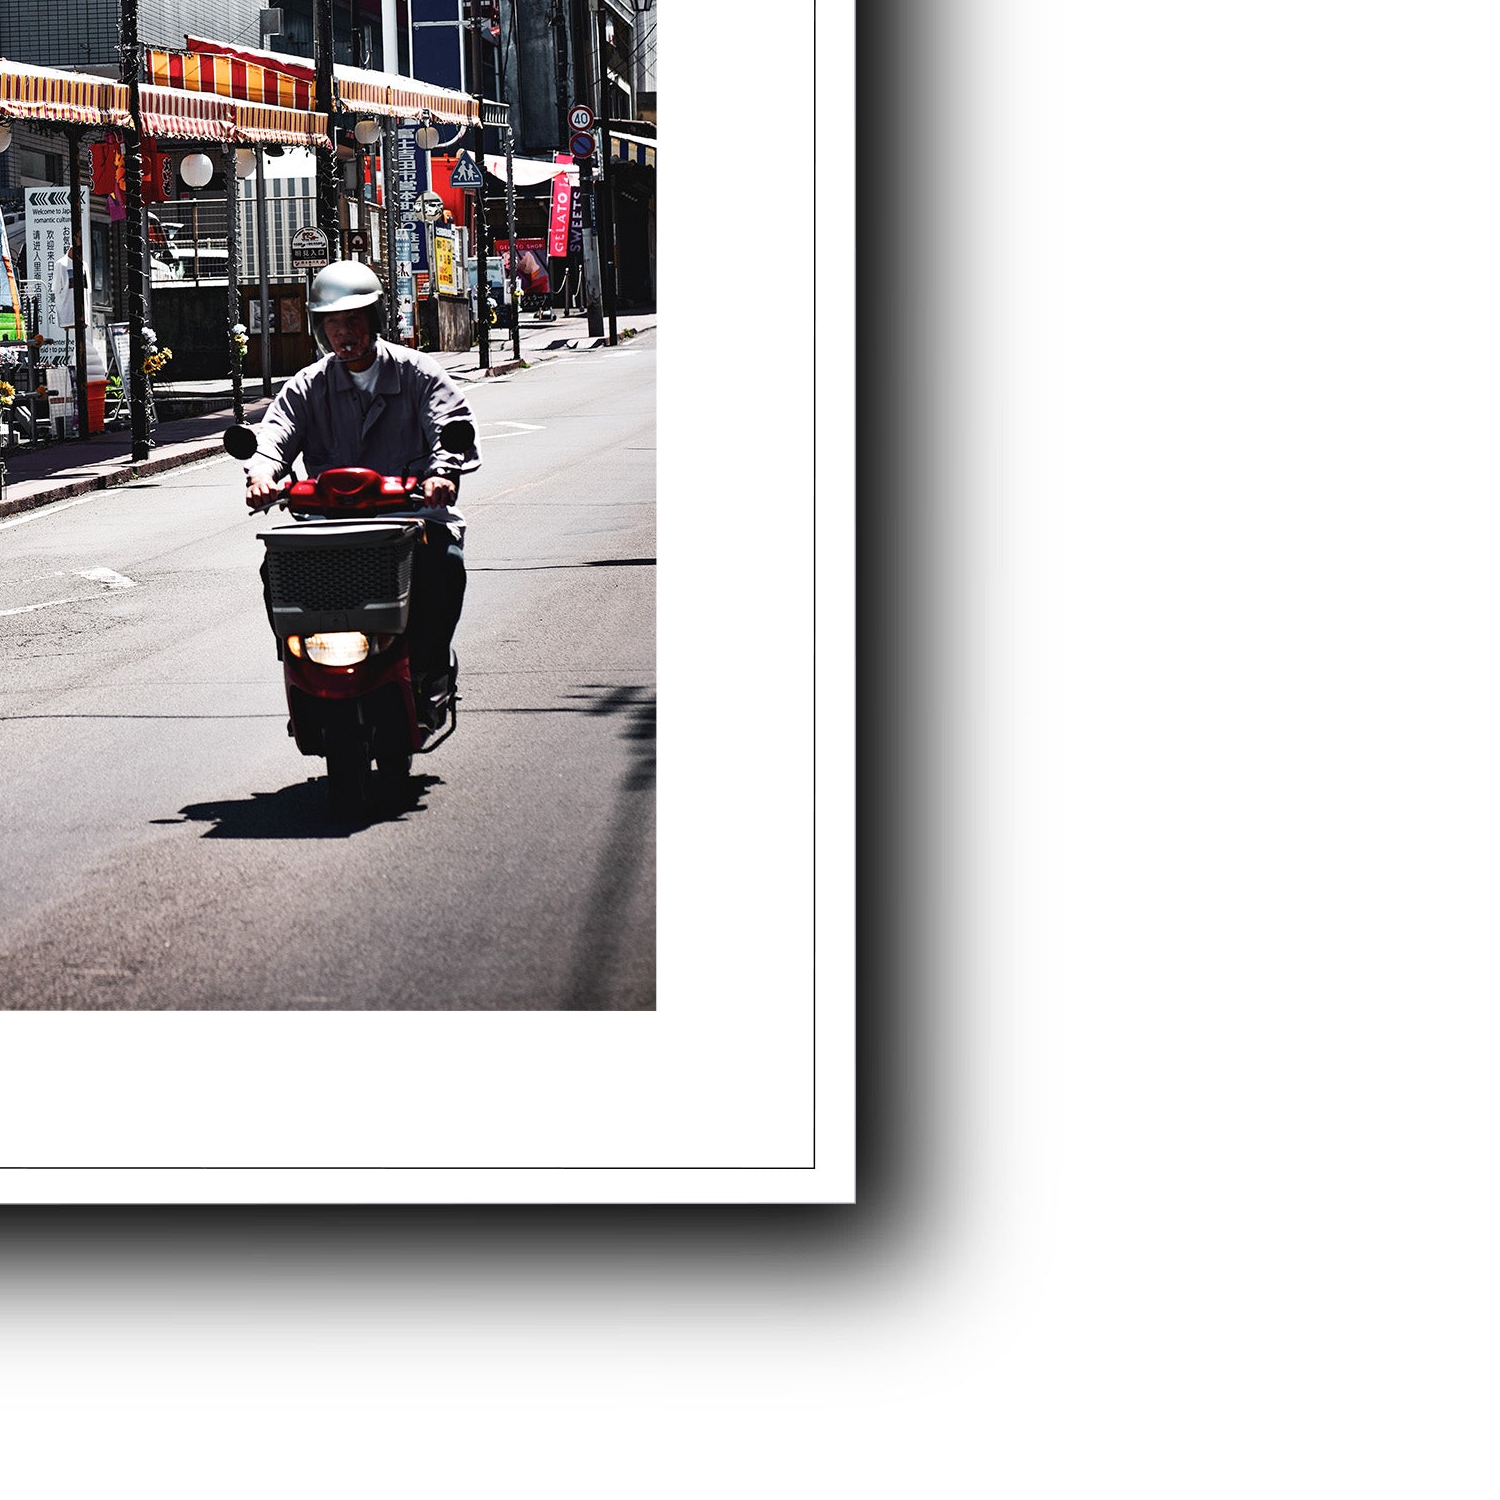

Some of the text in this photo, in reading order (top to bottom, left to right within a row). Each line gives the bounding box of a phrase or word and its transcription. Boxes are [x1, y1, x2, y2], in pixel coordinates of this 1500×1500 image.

[574, 113, 588, 125] 40
[554, 191, 569, 253] GELATO
[569, 191, 583, 253] SWEETS
